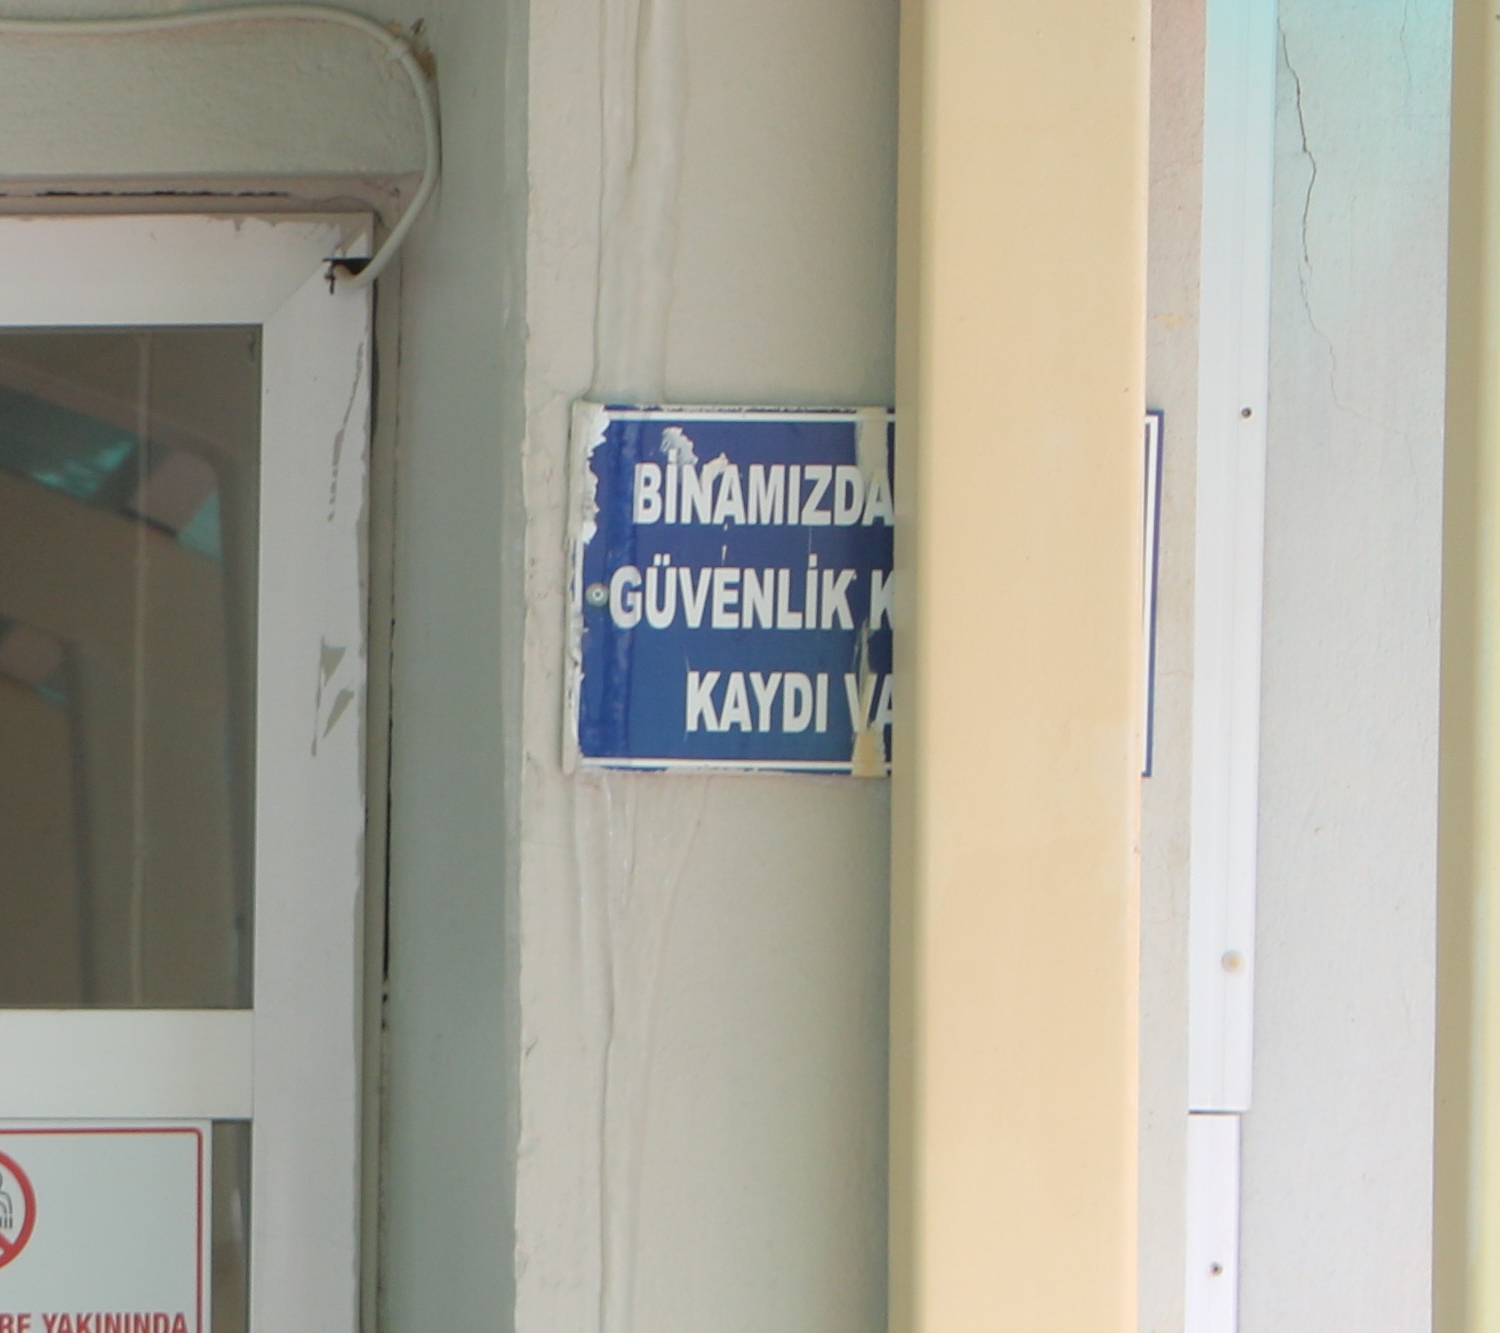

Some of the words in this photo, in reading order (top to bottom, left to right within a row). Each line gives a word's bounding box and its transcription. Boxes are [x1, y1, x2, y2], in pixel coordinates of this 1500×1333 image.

[633, 447, 895, 526] BİNAMIZDA
[609, 553, 855, 629] GÜVENLİK
[686, 671, 828, 733] KAYDI
